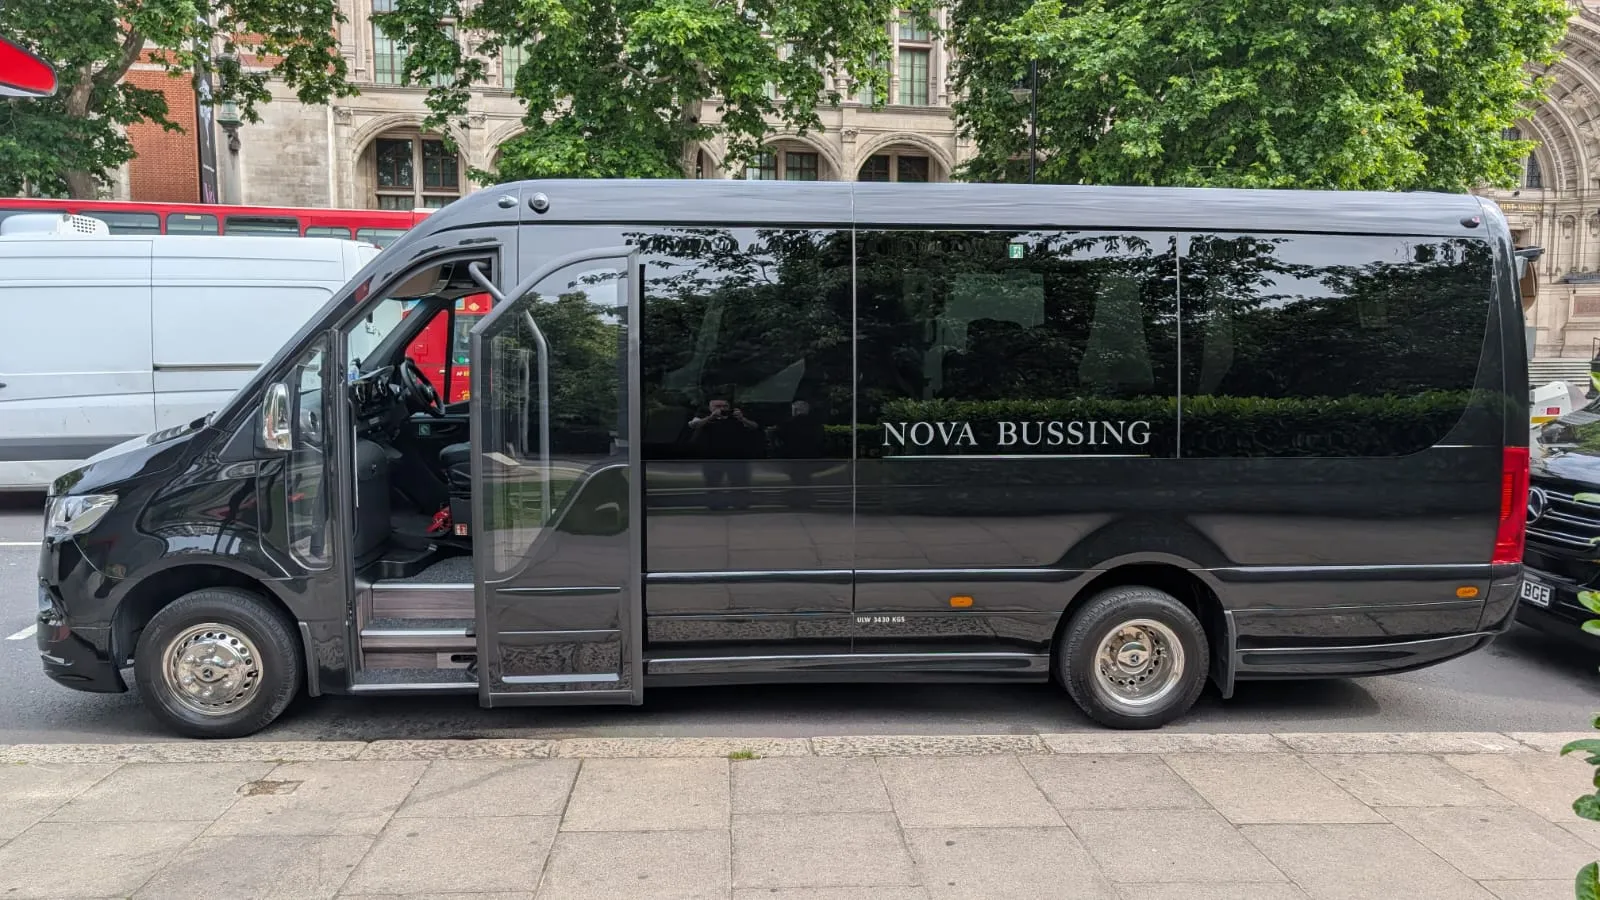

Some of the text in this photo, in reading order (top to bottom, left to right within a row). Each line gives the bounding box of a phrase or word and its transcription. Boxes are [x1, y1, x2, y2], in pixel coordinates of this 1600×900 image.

[882, 420, 1152, 447] NOVA BUSSING
[1523, 582, 1549, 604] BGE
